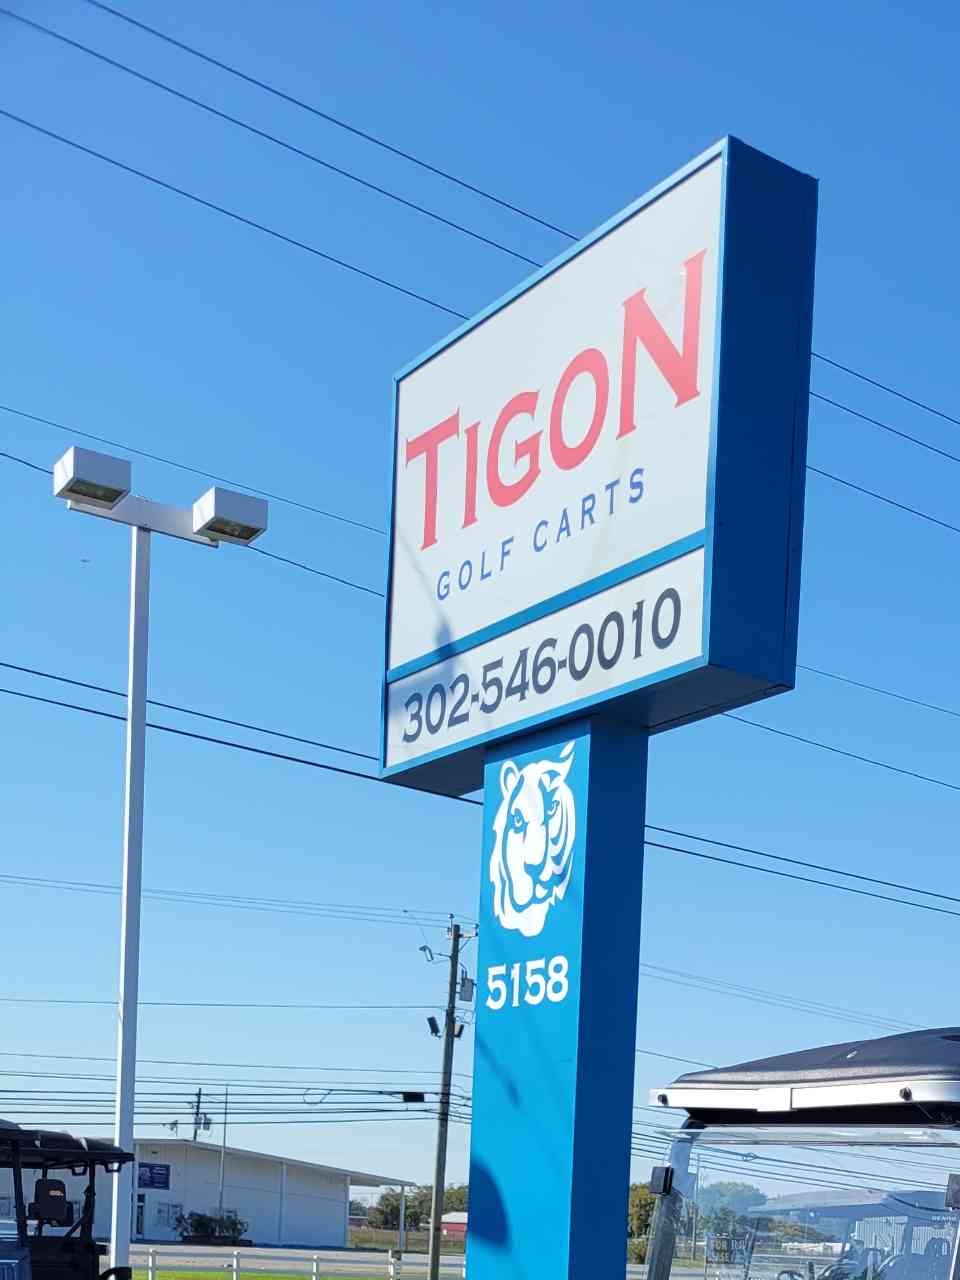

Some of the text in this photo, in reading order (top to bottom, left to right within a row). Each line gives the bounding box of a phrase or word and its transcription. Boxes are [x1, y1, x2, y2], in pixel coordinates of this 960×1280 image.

[405, 248, 706, 551] TIGON
[437, 481, 644, 601] GOLF CARTS
[402, 587, 682, 743] 302-546-0010
[485, 954, 569, 1010] 5158
